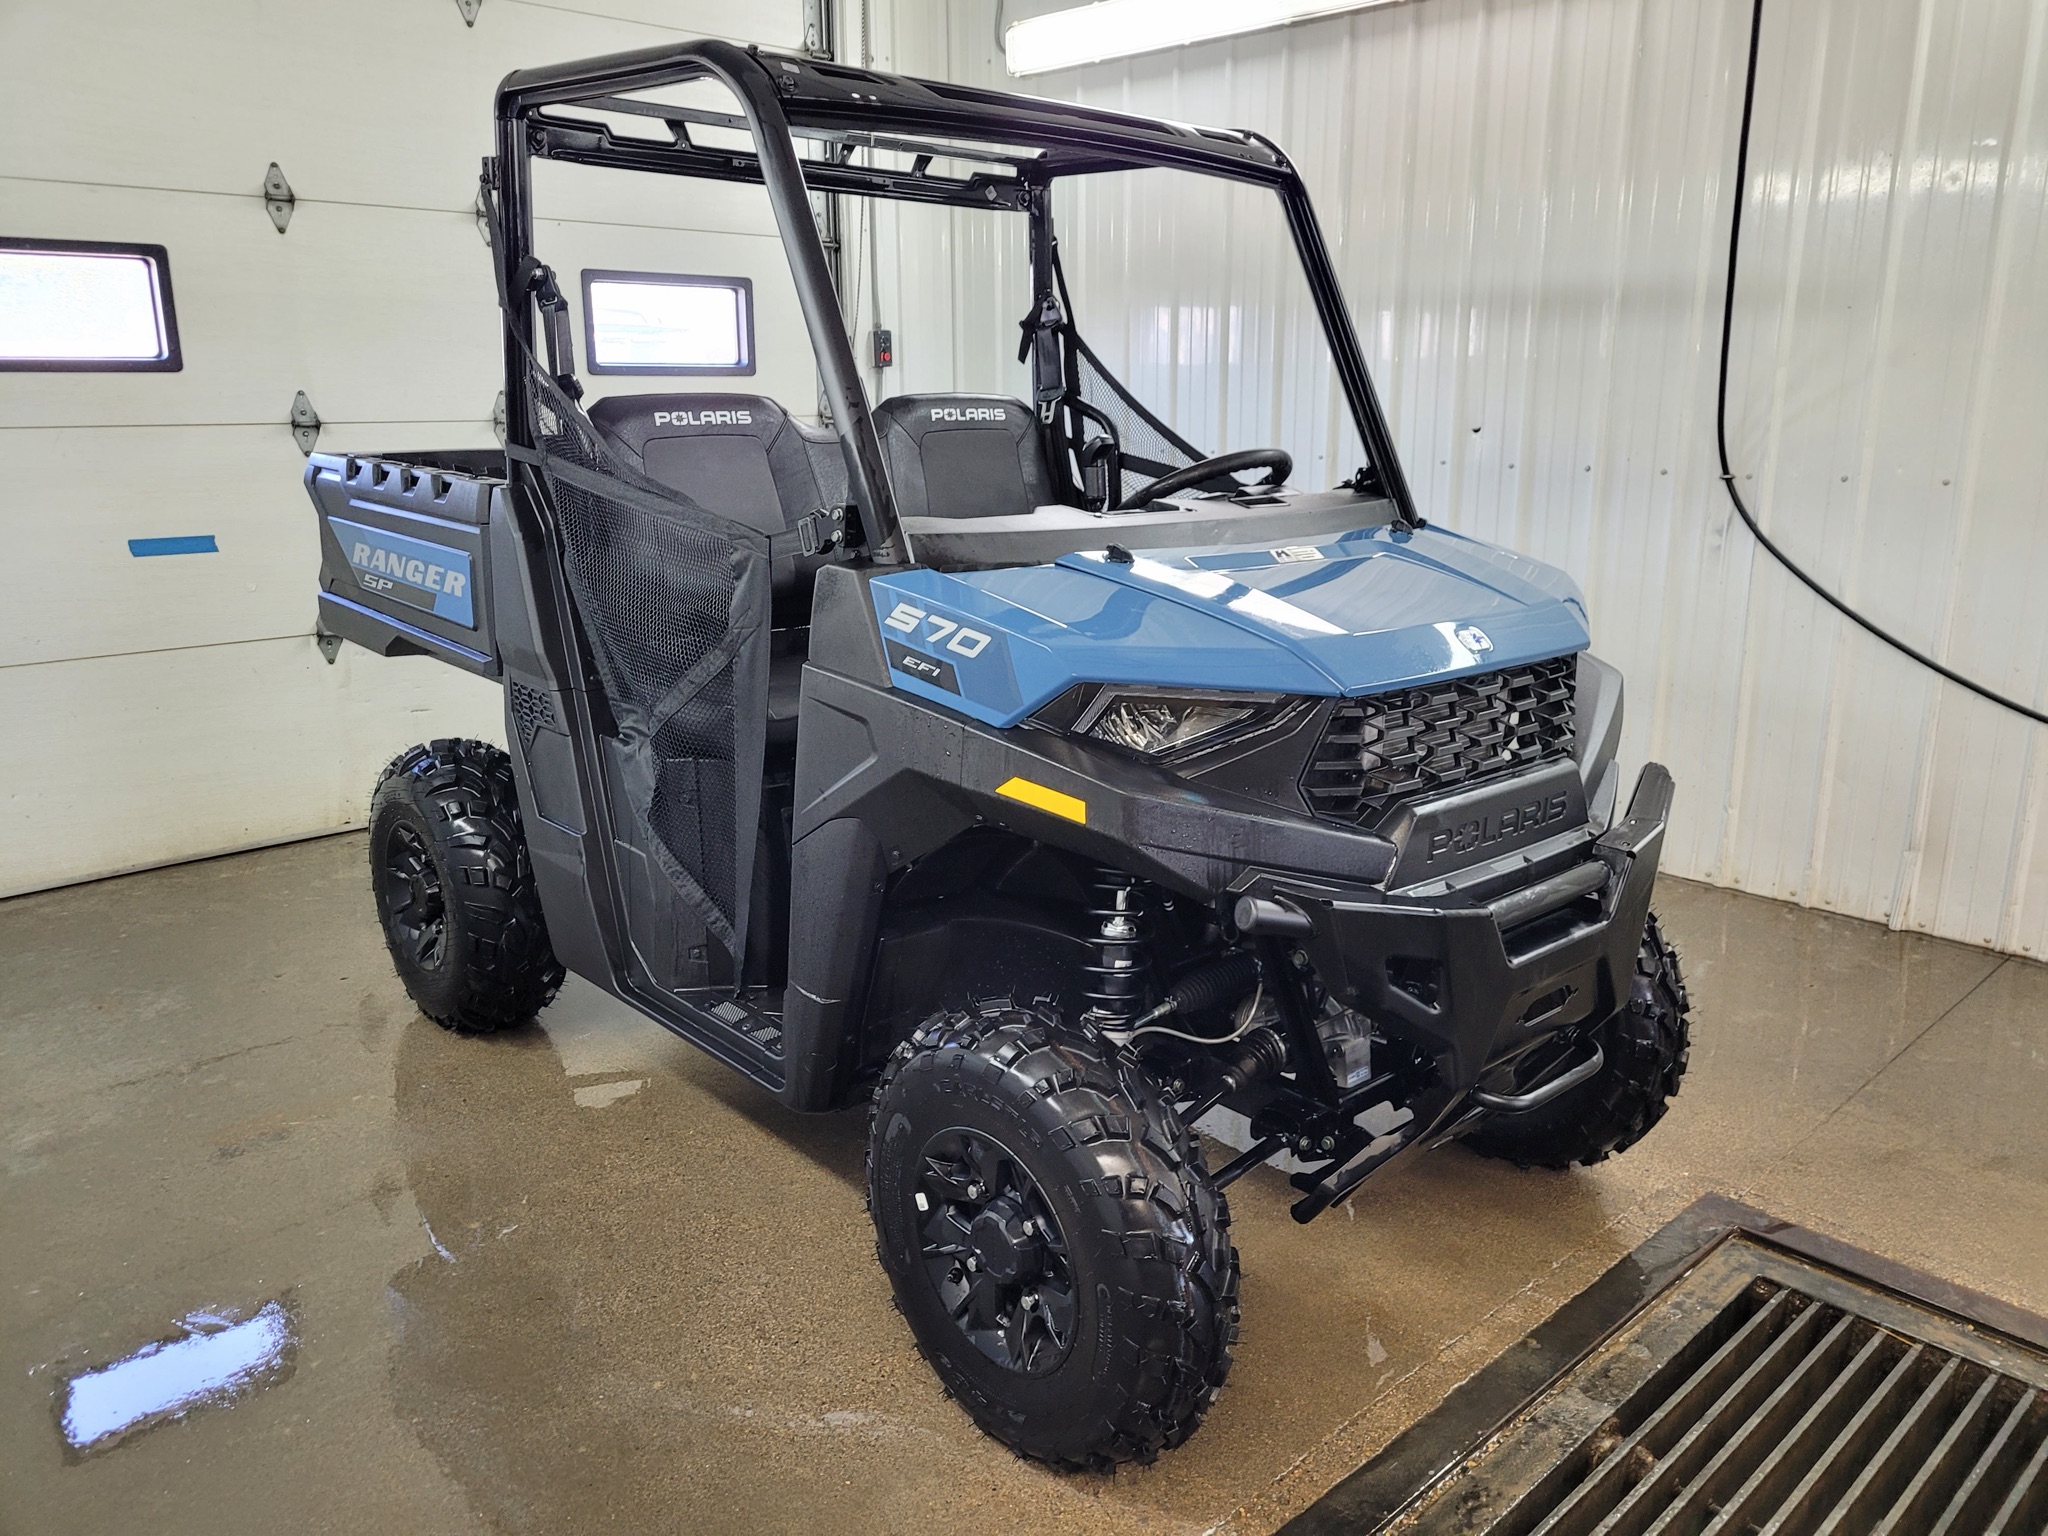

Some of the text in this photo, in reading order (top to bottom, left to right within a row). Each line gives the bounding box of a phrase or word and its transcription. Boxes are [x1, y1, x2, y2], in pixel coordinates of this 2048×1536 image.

[653, 409, 753, 427] POLARIS
[930, 407, 1007, 422] POLARIS
[353, 542, 467, 598] RANGER
[363, 574, 394, 591] SP
[883, 602, 992, 659] 570
[902, 655, 941, 677] EFI
[1426, 790, 1568, 864] POLARIS
